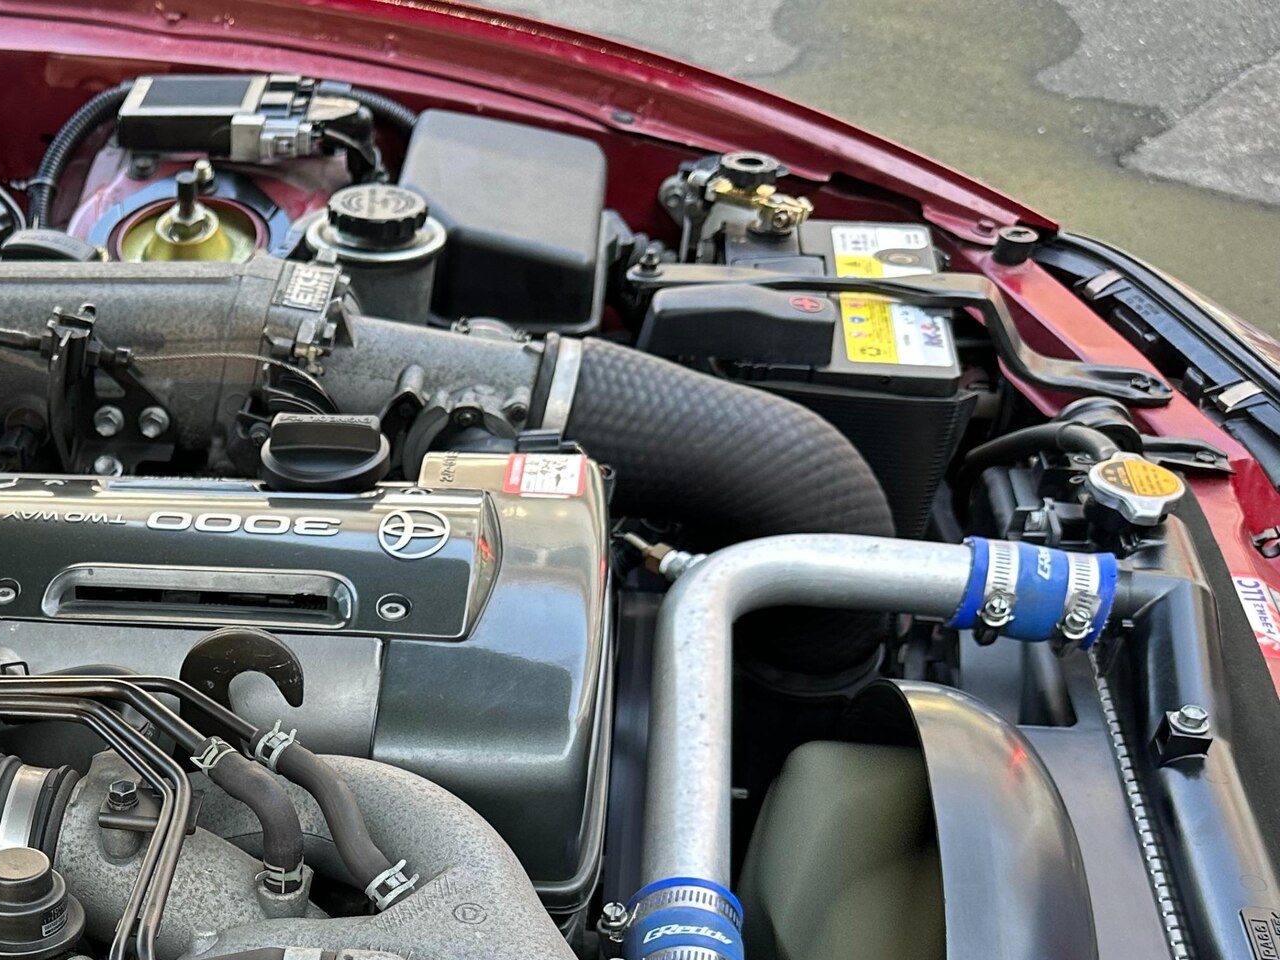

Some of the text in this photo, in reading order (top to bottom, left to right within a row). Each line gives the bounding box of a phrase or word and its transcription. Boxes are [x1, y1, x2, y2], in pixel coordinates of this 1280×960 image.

[2, 508, 59, 525] WAY
[63, 511, 126, 526] TWO
[145, 511, 342, 537] 3000
[1236, 579, 1267, 603] LLC
[642, 923, 733, 945] GReddy
[1253, 925, 1277, 958] PA66
